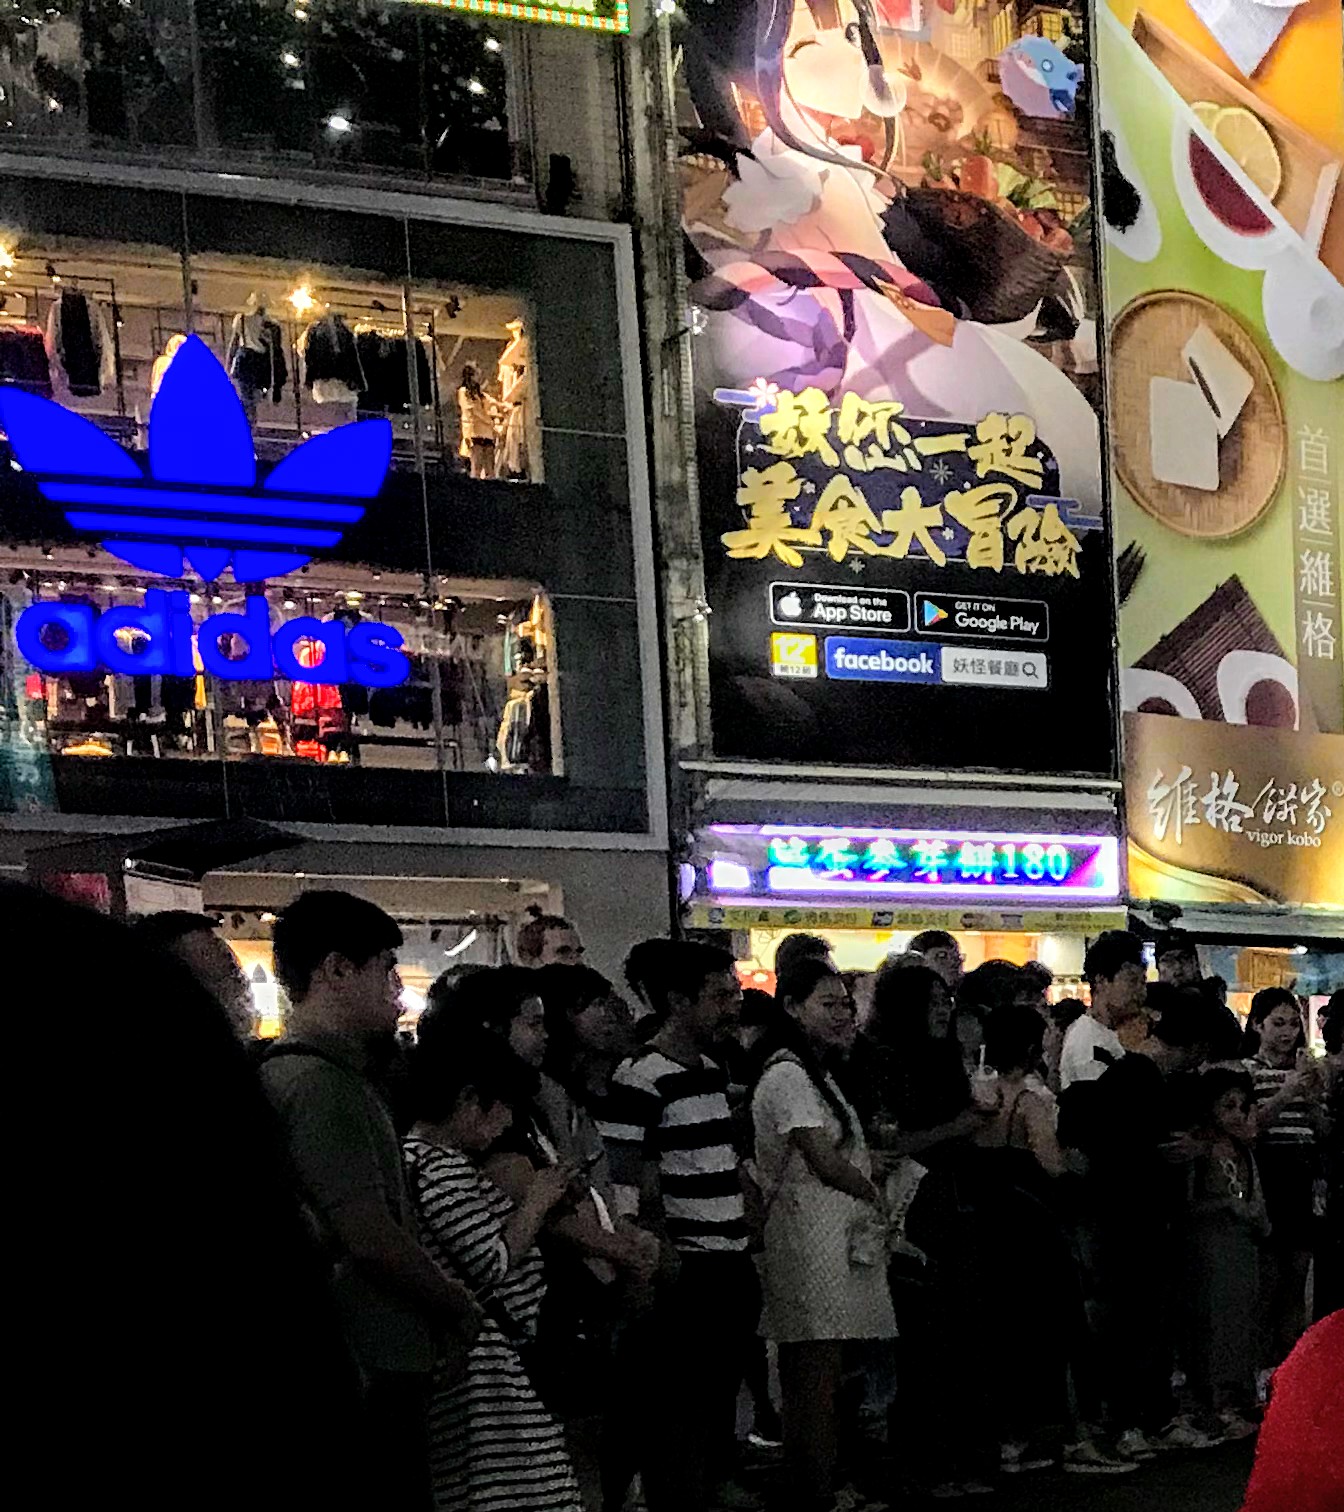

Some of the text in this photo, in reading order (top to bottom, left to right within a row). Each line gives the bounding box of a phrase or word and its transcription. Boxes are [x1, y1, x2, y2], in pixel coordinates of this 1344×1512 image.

[722, 462, 1080, 579] 美食大冒險
[1297, 424, 1338, 662] 首選維格
[814, 593, 888, 606] Download on the
[954, 601, 975, 611] GET
[814, 605, 893, 624] App Store
[954, 612, 1040, 636] Google Play
[15, 590, 410, 688] adidas
[833, 647, 934, 675] facebook
[1246, 828, 1322, 849] vigor kobo
